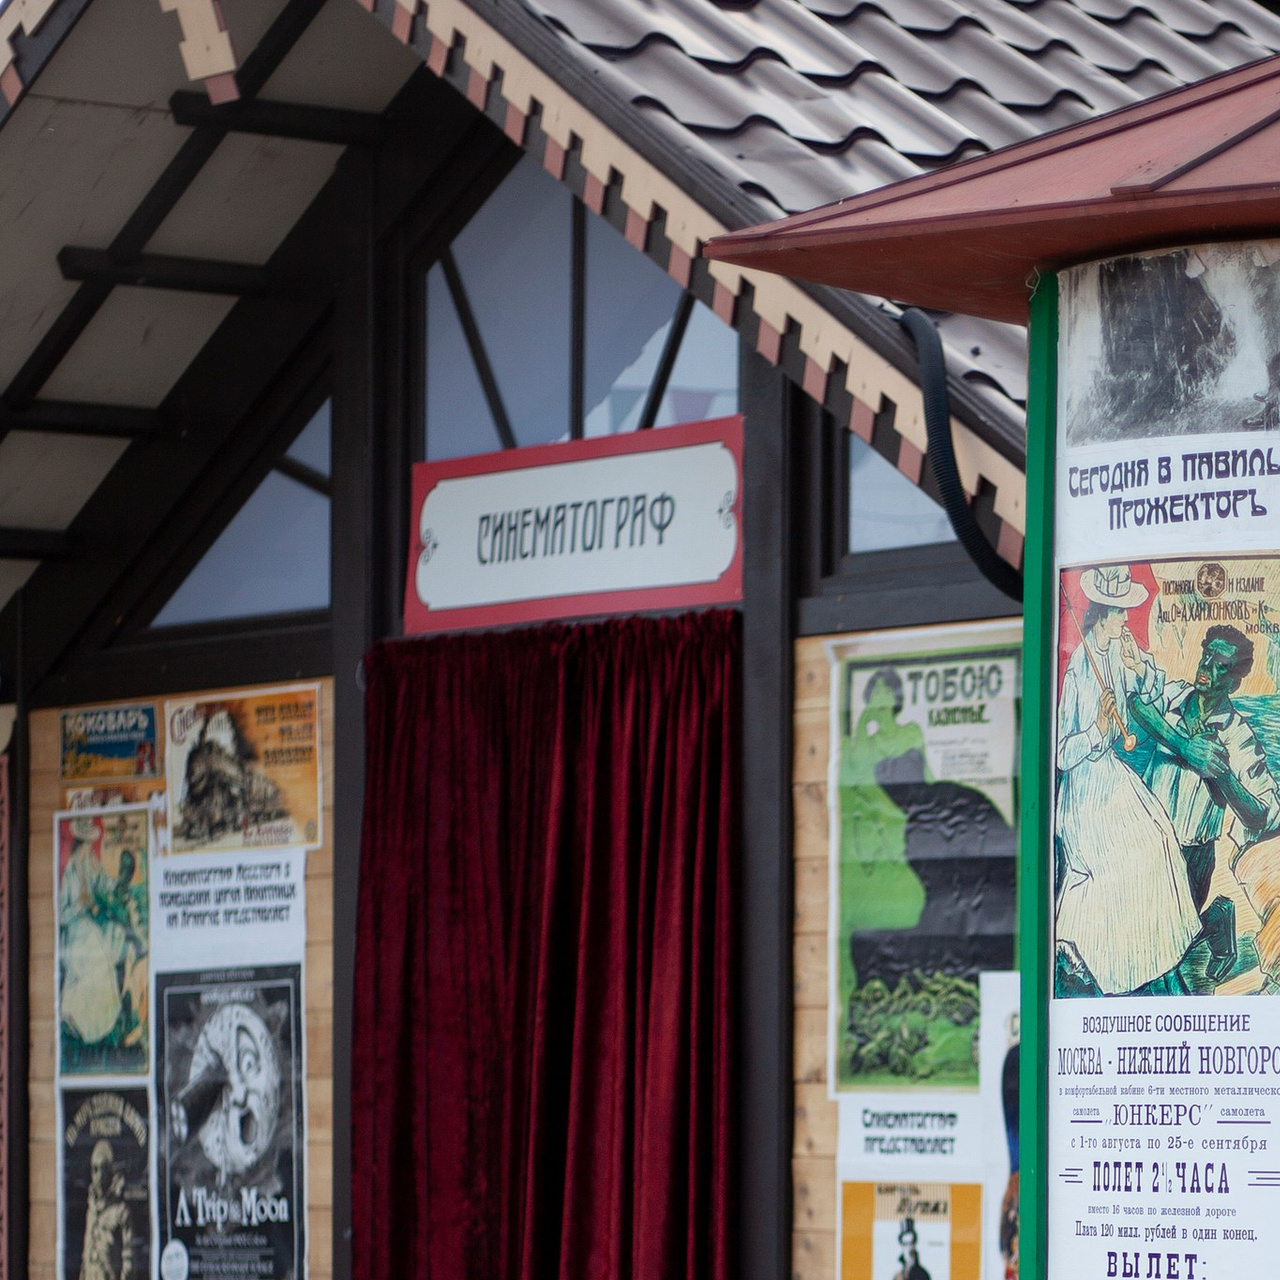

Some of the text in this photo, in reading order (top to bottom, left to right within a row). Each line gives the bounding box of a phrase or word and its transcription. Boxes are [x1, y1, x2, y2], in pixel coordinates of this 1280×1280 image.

[1158, 456, 1171, 484] В
[907, 664, 1002, 705] ТОБОЮ
[1083, 1014, 1250, 1034] ВОЗДУШНОЕ СООБЩЕНИЕ
[1057, 1047, 1103, 1075] МОСКВА
[1117, 1041, 1191, 1074] НИЖНИЙ
[1121, 1085, 1145, 1095] кабине
[1148, 1086, 1165, 1095] 6-ти
[1169, 1087, 1209, 1095] местного
[1073, 1107, 1100, 1117] самолета
[1220, 1107, 1265, 1117] самолета
[1071, 1136, 1268, 1153] с 1-го августа по 25-е сентября
[1093, 1161, 1230, 1194] ПОЛЕТ ЧАСА
[1088, 1204, 1236, 1218] вместо 16 часов по железной дороге
[1075, 1220, 1258, 1242] Плата 120 милл. рублей в один конец.
